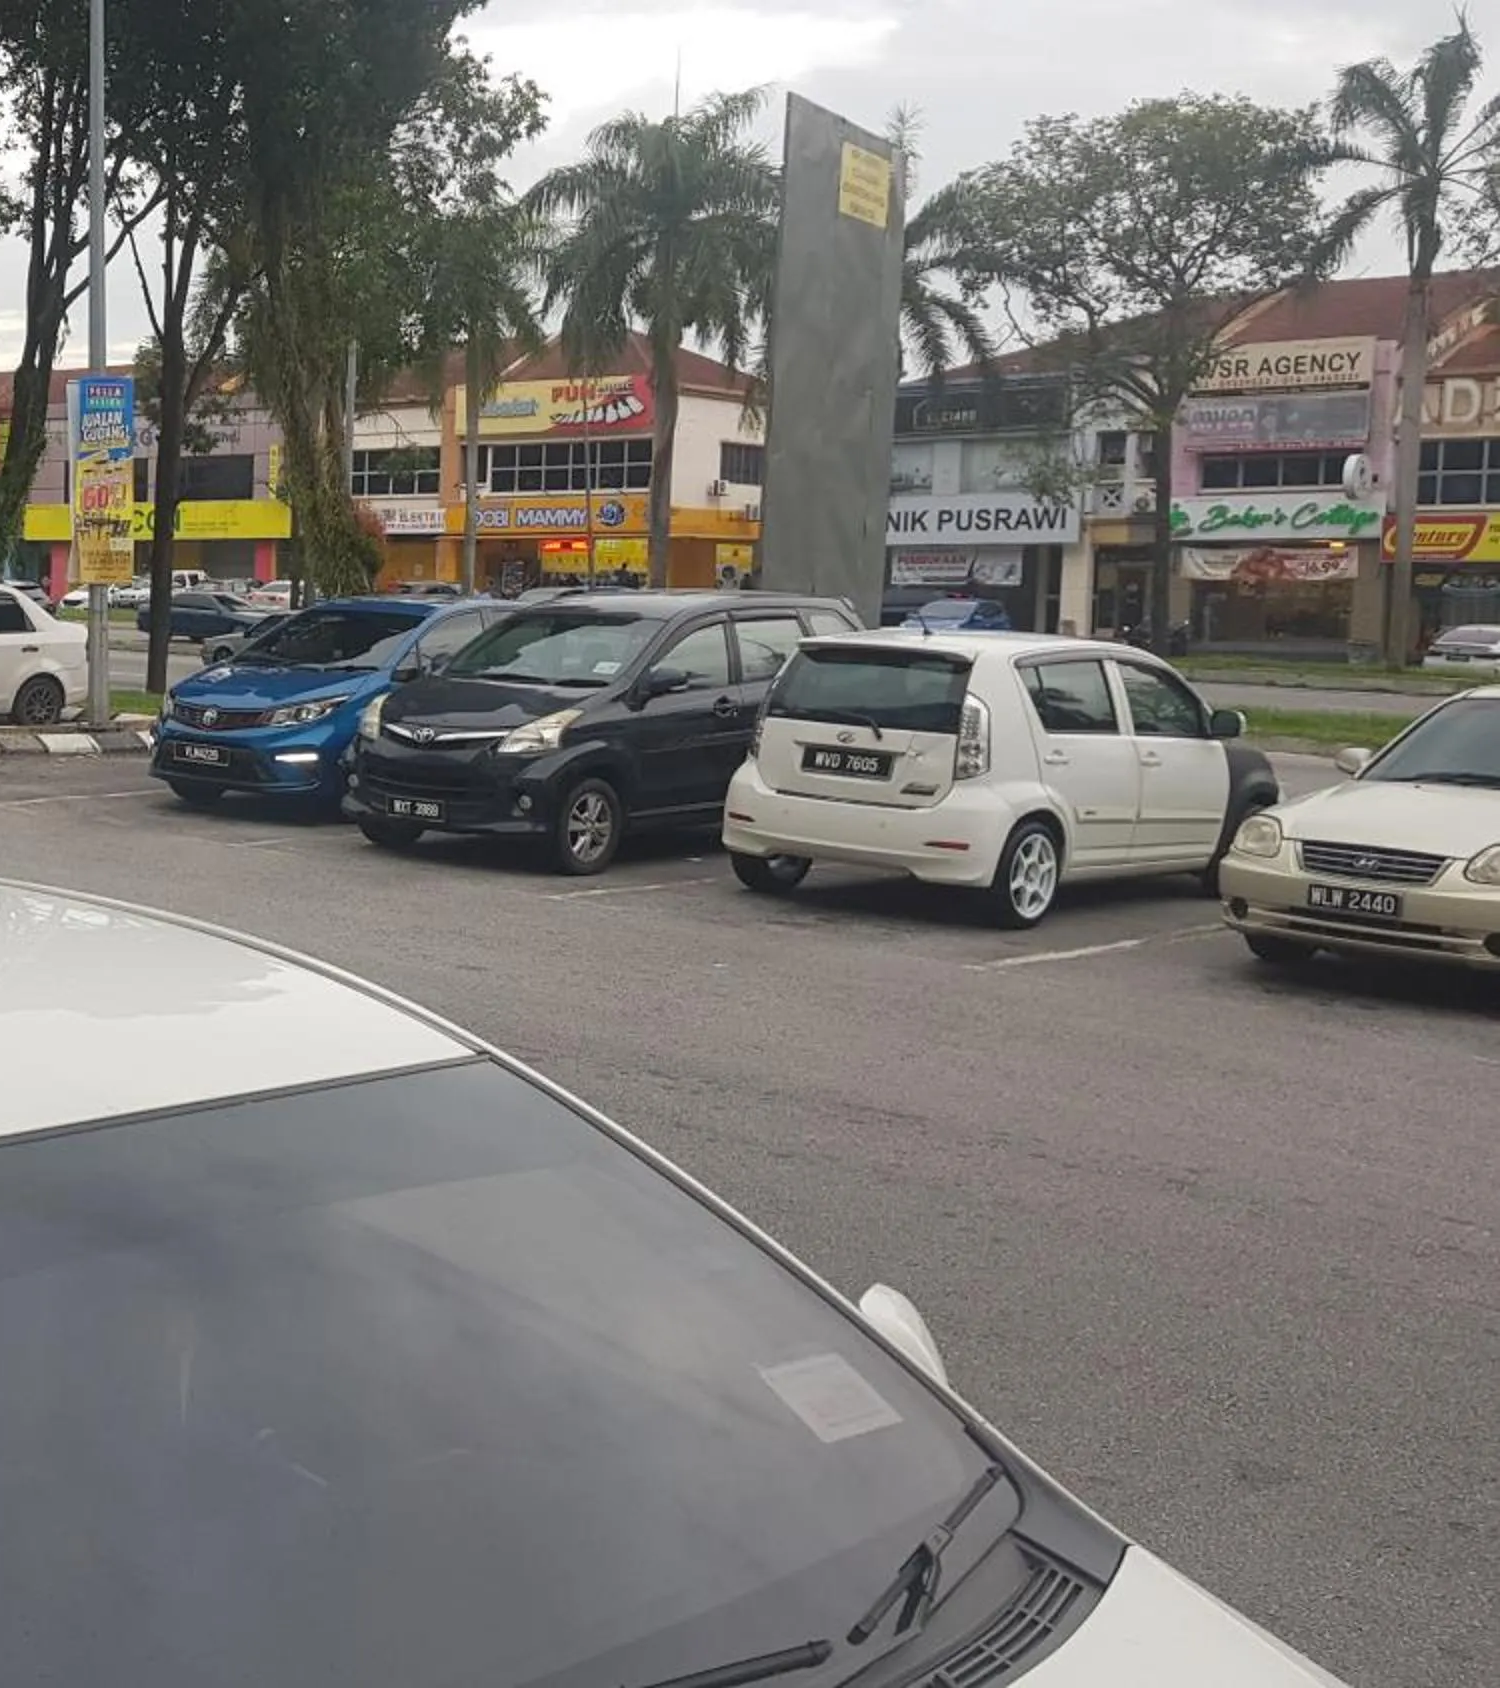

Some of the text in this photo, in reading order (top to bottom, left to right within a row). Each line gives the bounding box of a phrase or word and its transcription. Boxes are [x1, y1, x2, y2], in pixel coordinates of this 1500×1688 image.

[1257, 352, 1361, 376] AGENCY
[516, 508, 588, 529] MAMMY
[886, 506, 1068, 533] NIK PUSRAWI
[1198, 502, 1380, 535] Baker's Cottage
[815, 751, 880, 773] WVD 7605
[1311, 887, 1396, 914] WLW 2440
